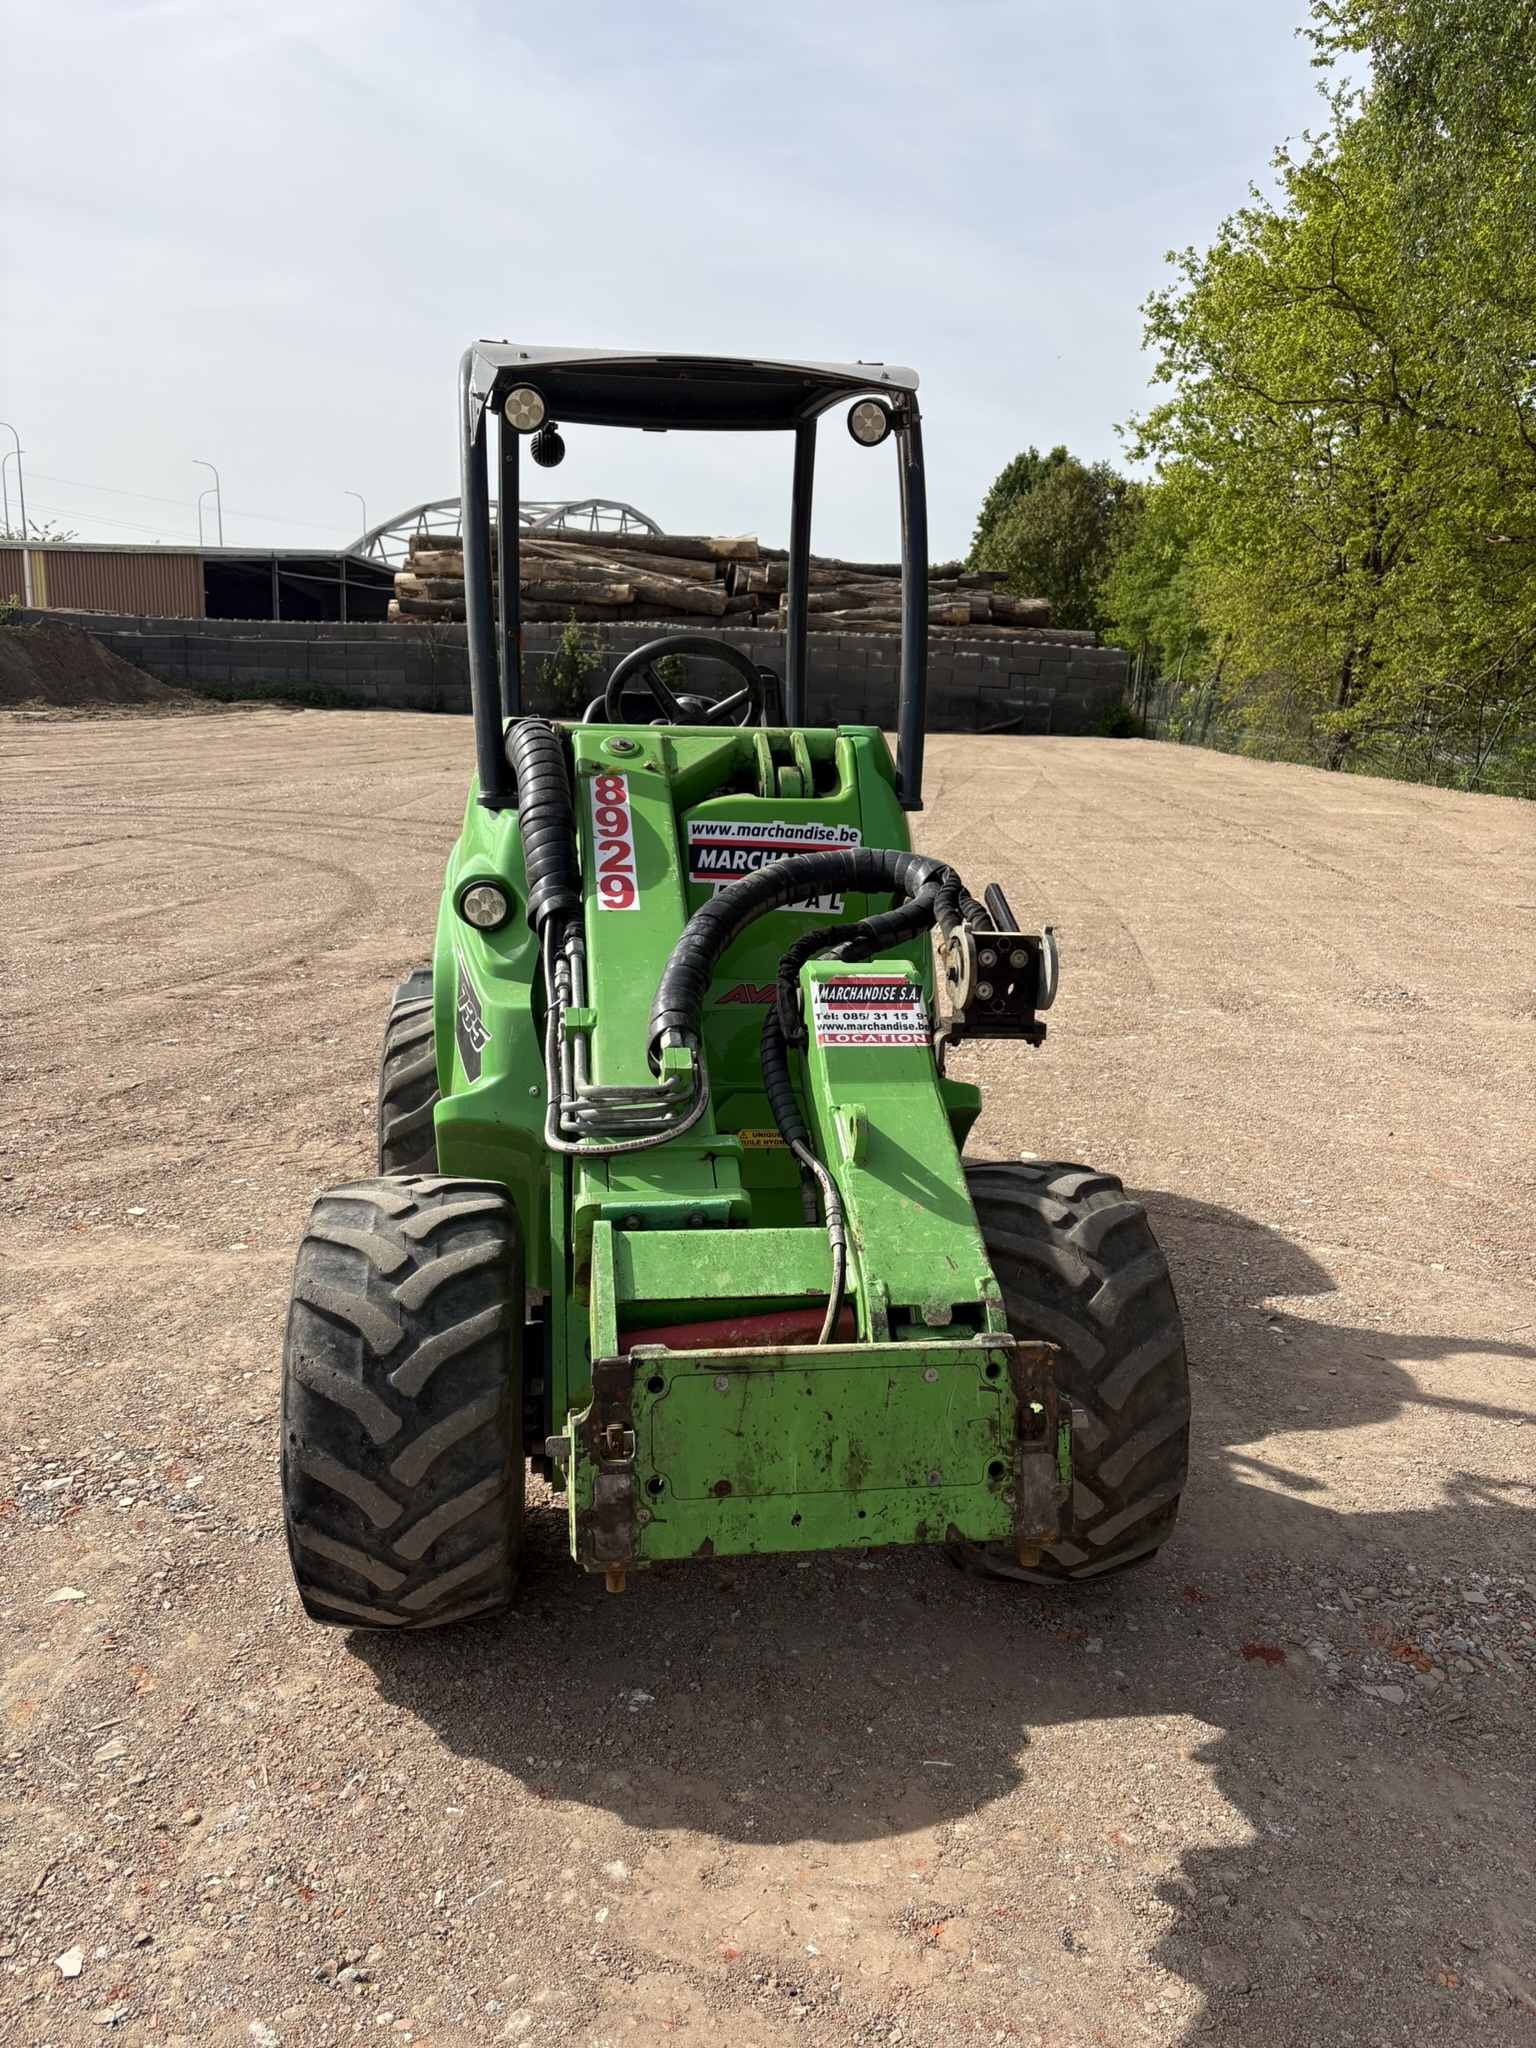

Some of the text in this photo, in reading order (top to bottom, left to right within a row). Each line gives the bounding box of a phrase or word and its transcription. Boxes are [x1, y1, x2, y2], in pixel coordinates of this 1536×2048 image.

[692, 824, 858, 842] www.marchandise.be
[595, 776, 635, 909] 8929
[820, 986, 920, 1001] MARCHANDISE S.A.
[843, 1012, 870, 1021] 085/
[873, 1012, 888, 1020] 31
[891, 1012, 908, 1020] 15
[817, 1022, 930, 1032] www.marchandise.be
[824, 1034, 927, 1043] LOCATION
